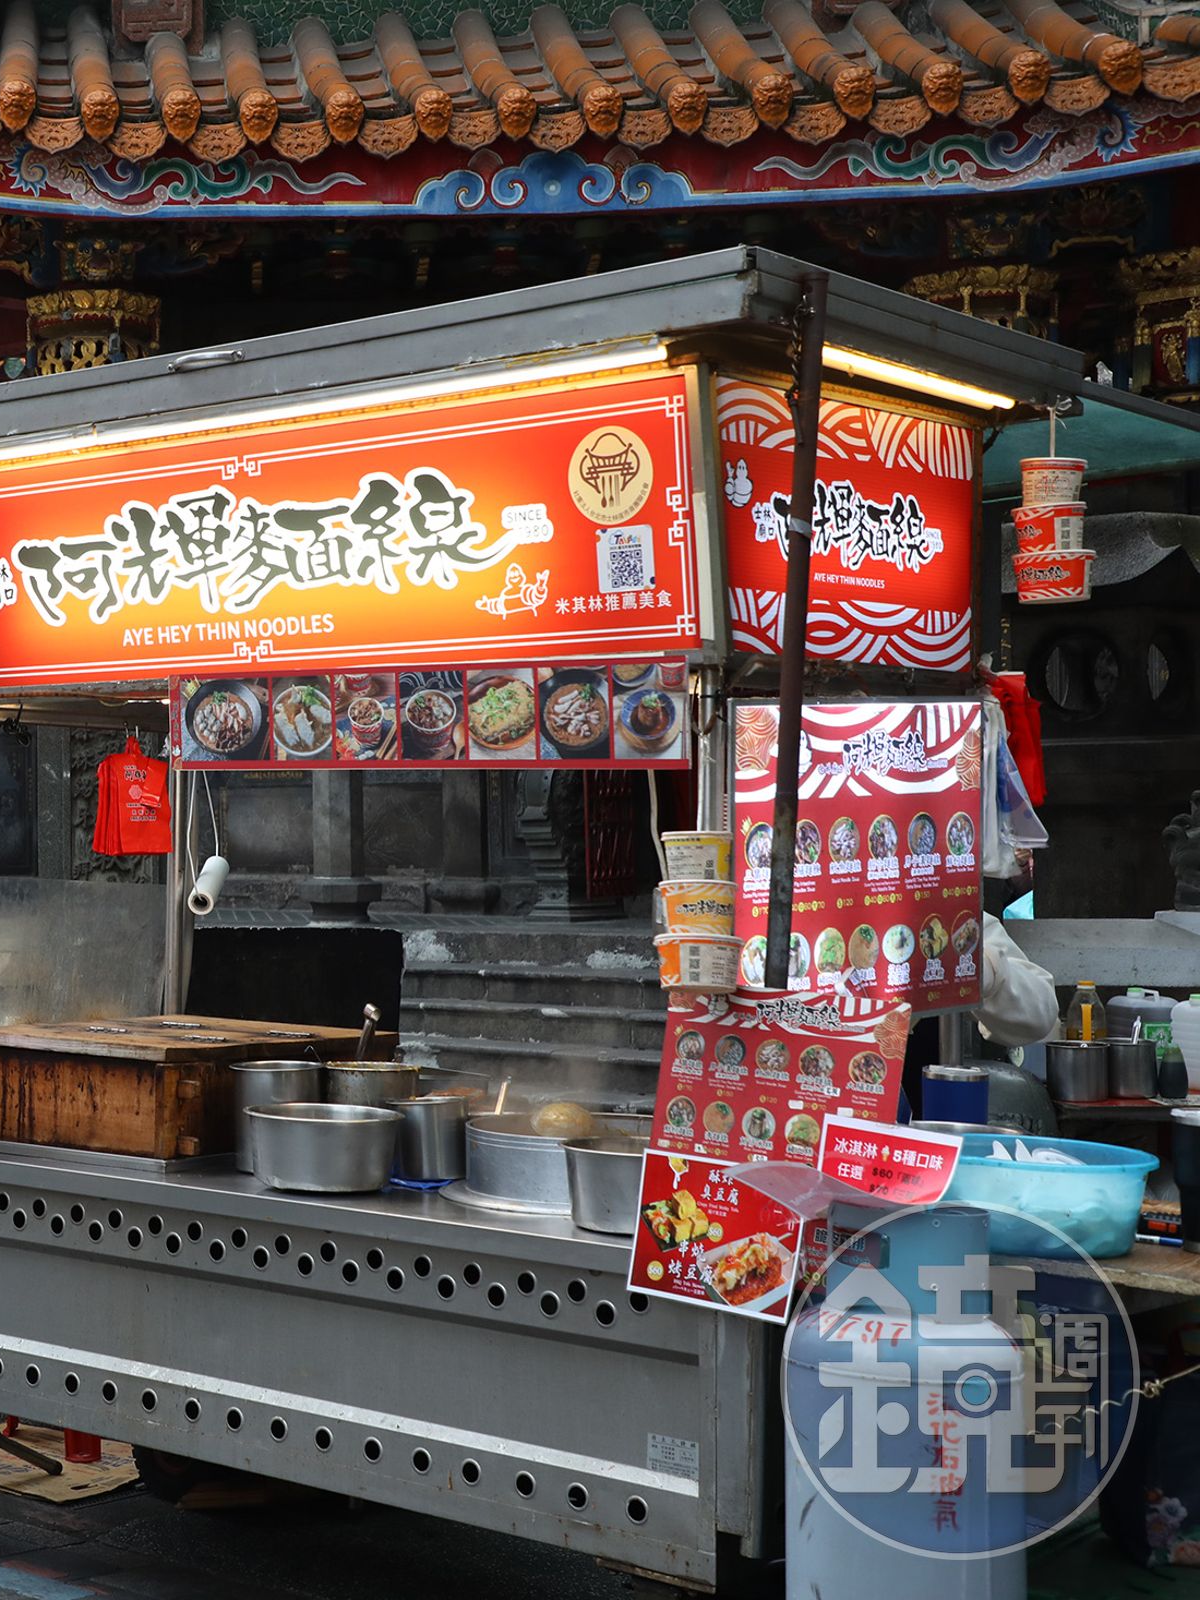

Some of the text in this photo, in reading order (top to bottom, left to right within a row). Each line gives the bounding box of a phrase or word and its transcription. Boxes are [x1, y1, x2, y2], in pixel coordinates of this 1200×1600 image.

[507, 508, 542, 523] SINCE
[518, 525, 550, 538] 980
[17, 472, 494, 621] 阿輝麵線
[814, 572, 886, 589] AYE HEY THIN NOODLES
[555, 590, 672, 615] 米其林推薦美食
[123, 613, 335, 647] AYE HEY THIN NOODLES
[834, 1137, 878, 1159] 冰淇淋
[892, 1149, 944, 1171] 5種口味
[838, 1162, 864, 1180] 任選
[872, 1167, 893, 1179] $60
[700, 1184, 739, 1206] 臭豆腐
[668, 1259, 713, 1285] 烤豆腐
